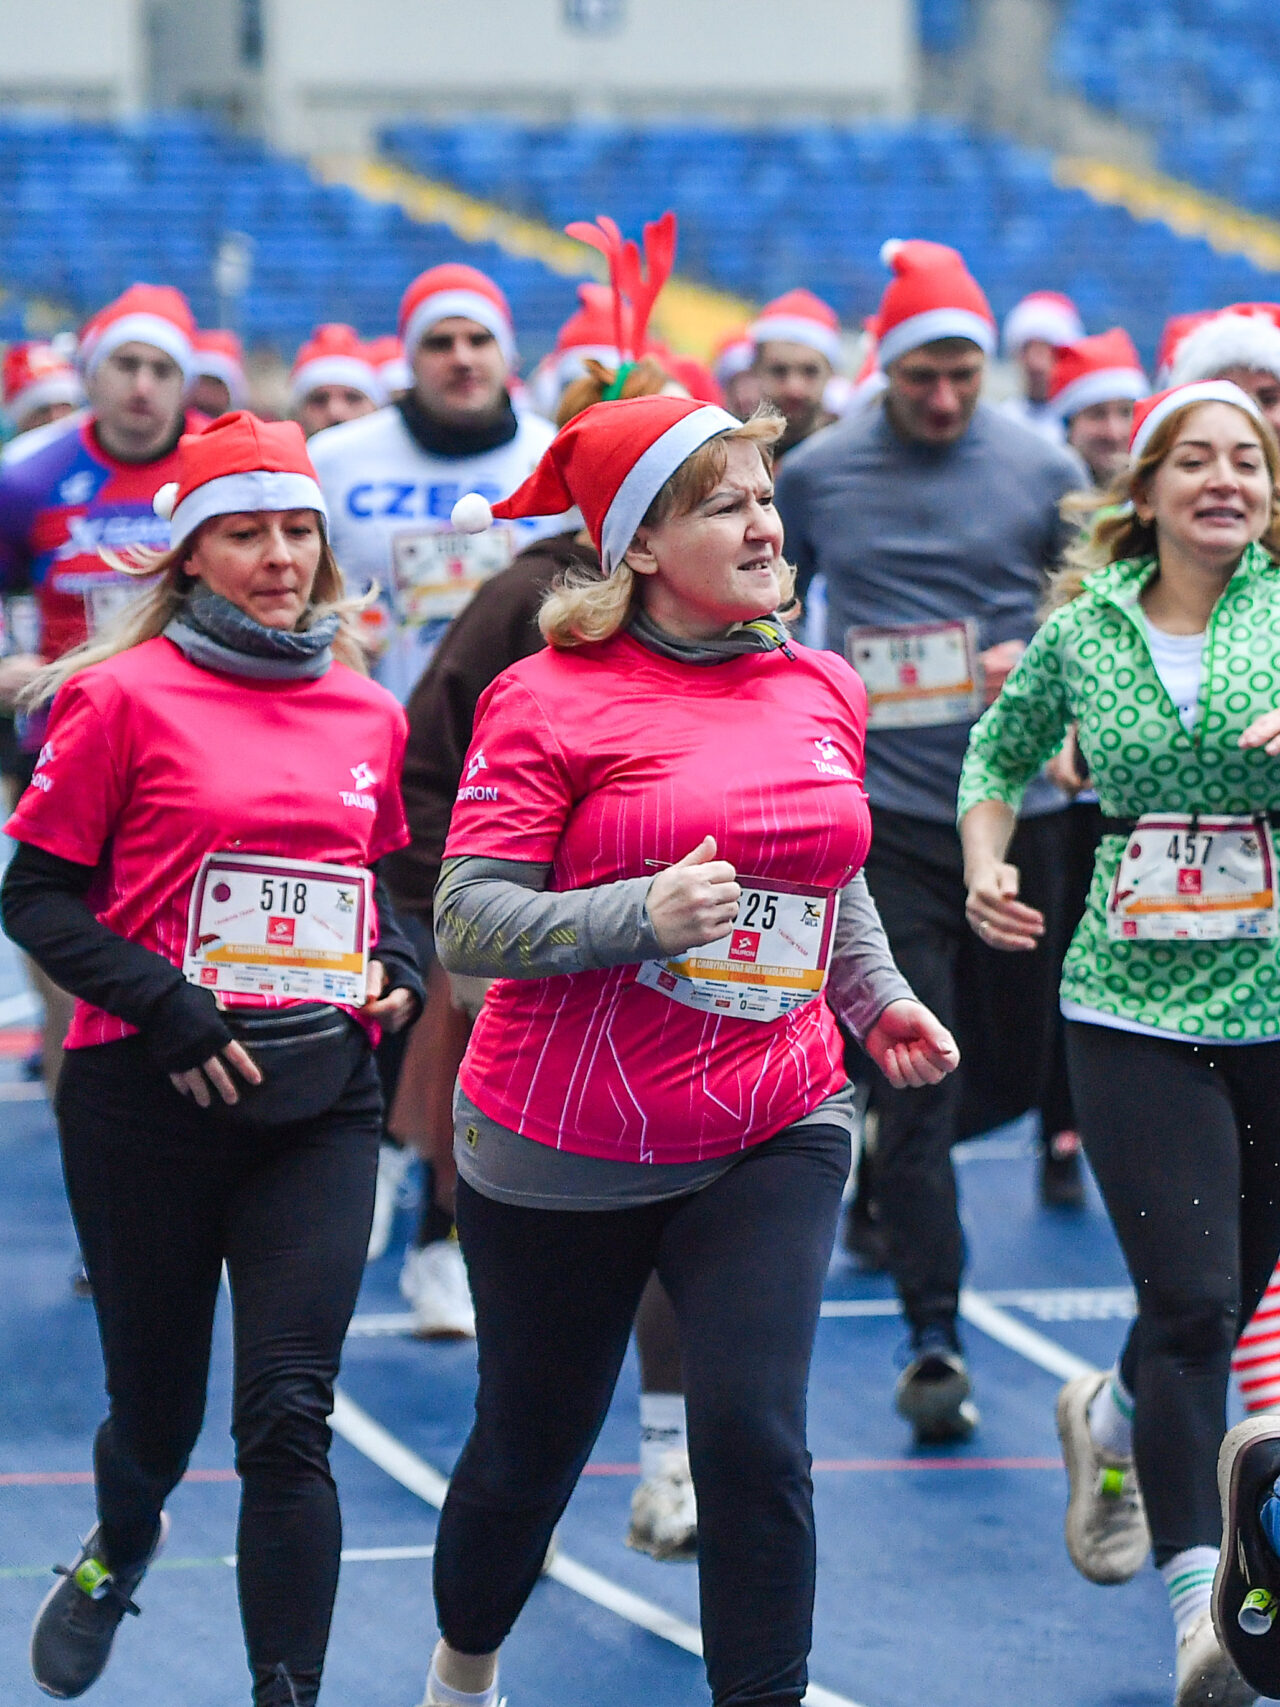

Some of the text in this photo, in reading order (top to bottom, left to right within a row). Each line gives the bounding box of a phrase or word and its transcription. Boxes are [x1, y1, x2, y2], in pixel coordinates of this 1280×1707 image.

[1167, 835, 1213, 865] 457
[260, 879, 307, 914] 518
[732, 891, 779, 930] 25
